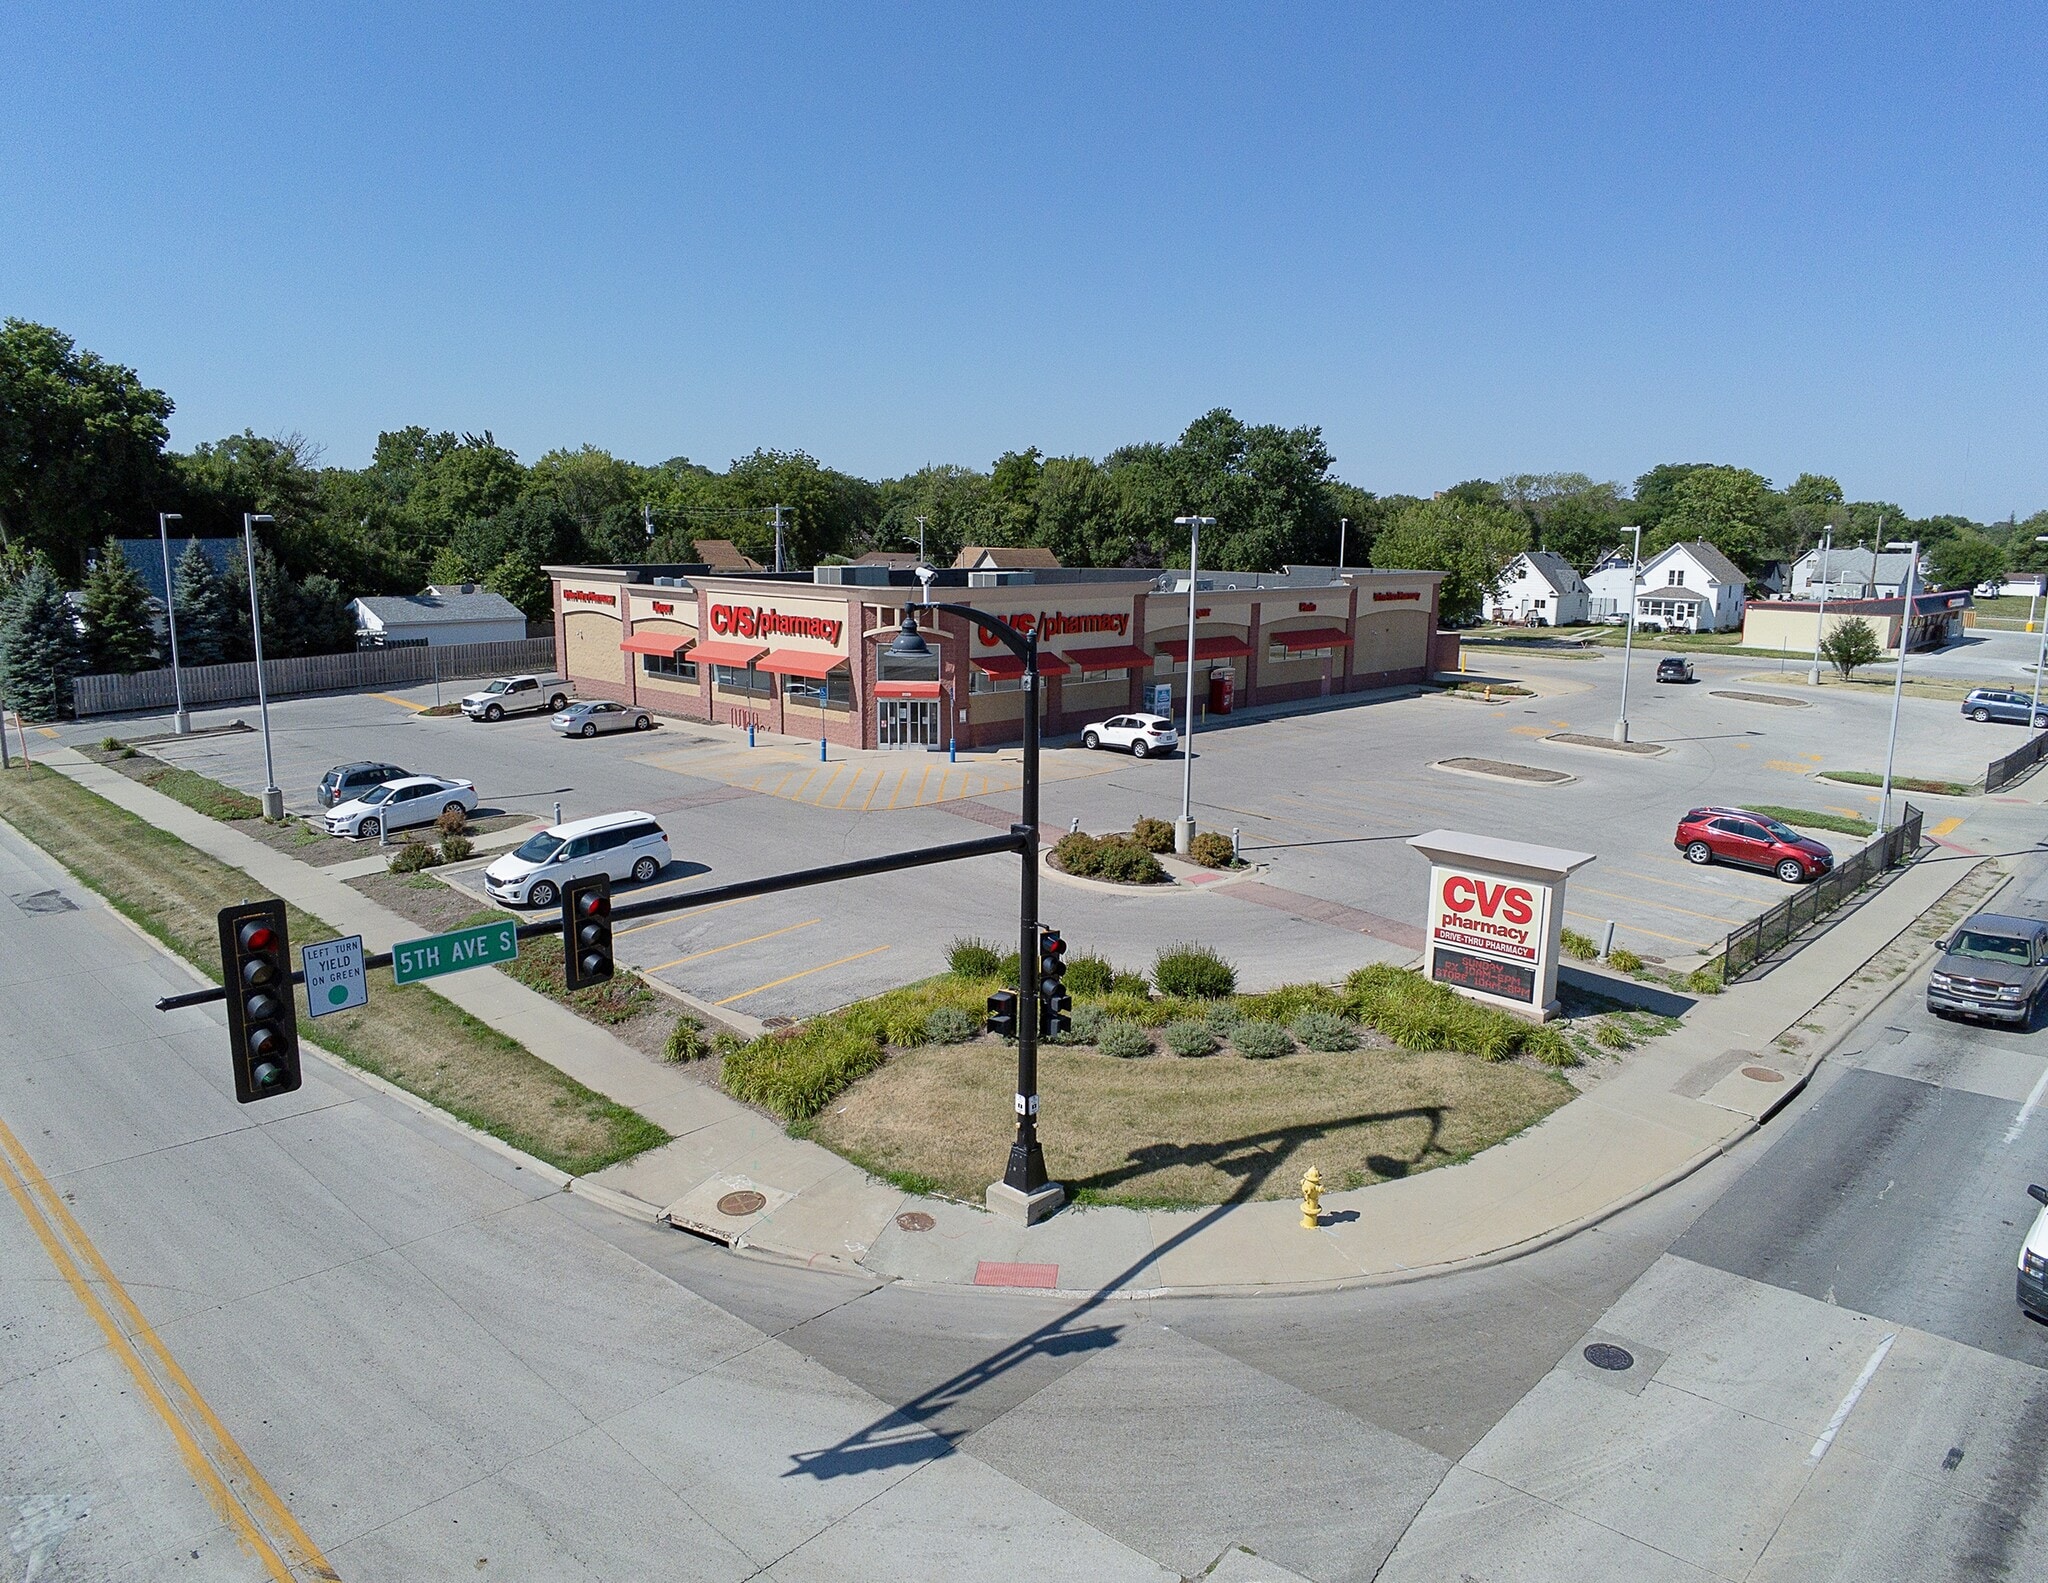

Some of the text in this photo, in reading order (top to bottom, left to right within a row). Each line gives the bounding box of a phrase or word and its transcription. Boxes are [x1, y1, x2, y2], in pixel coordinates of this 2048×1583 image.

[710, 604, 842, 647] CVS/pharmacy
[1443, 876, 1533, 925] CVS
[1442, 913, 1529, 944] pharmacy
[307, 941, 358, 960] LEFT TURN
[400, 931, 511, 974] 5TH AVE S
[1440, 930, 1529, 956] DRIVE-THRU PHARMACY
[319, 955, 351, 972] YIELD
[1462, 957, 1504, 972] SUNDAY
[312, 968, 360, 987] ON GREEN
[1435, 967, 1468, 983] STORE
